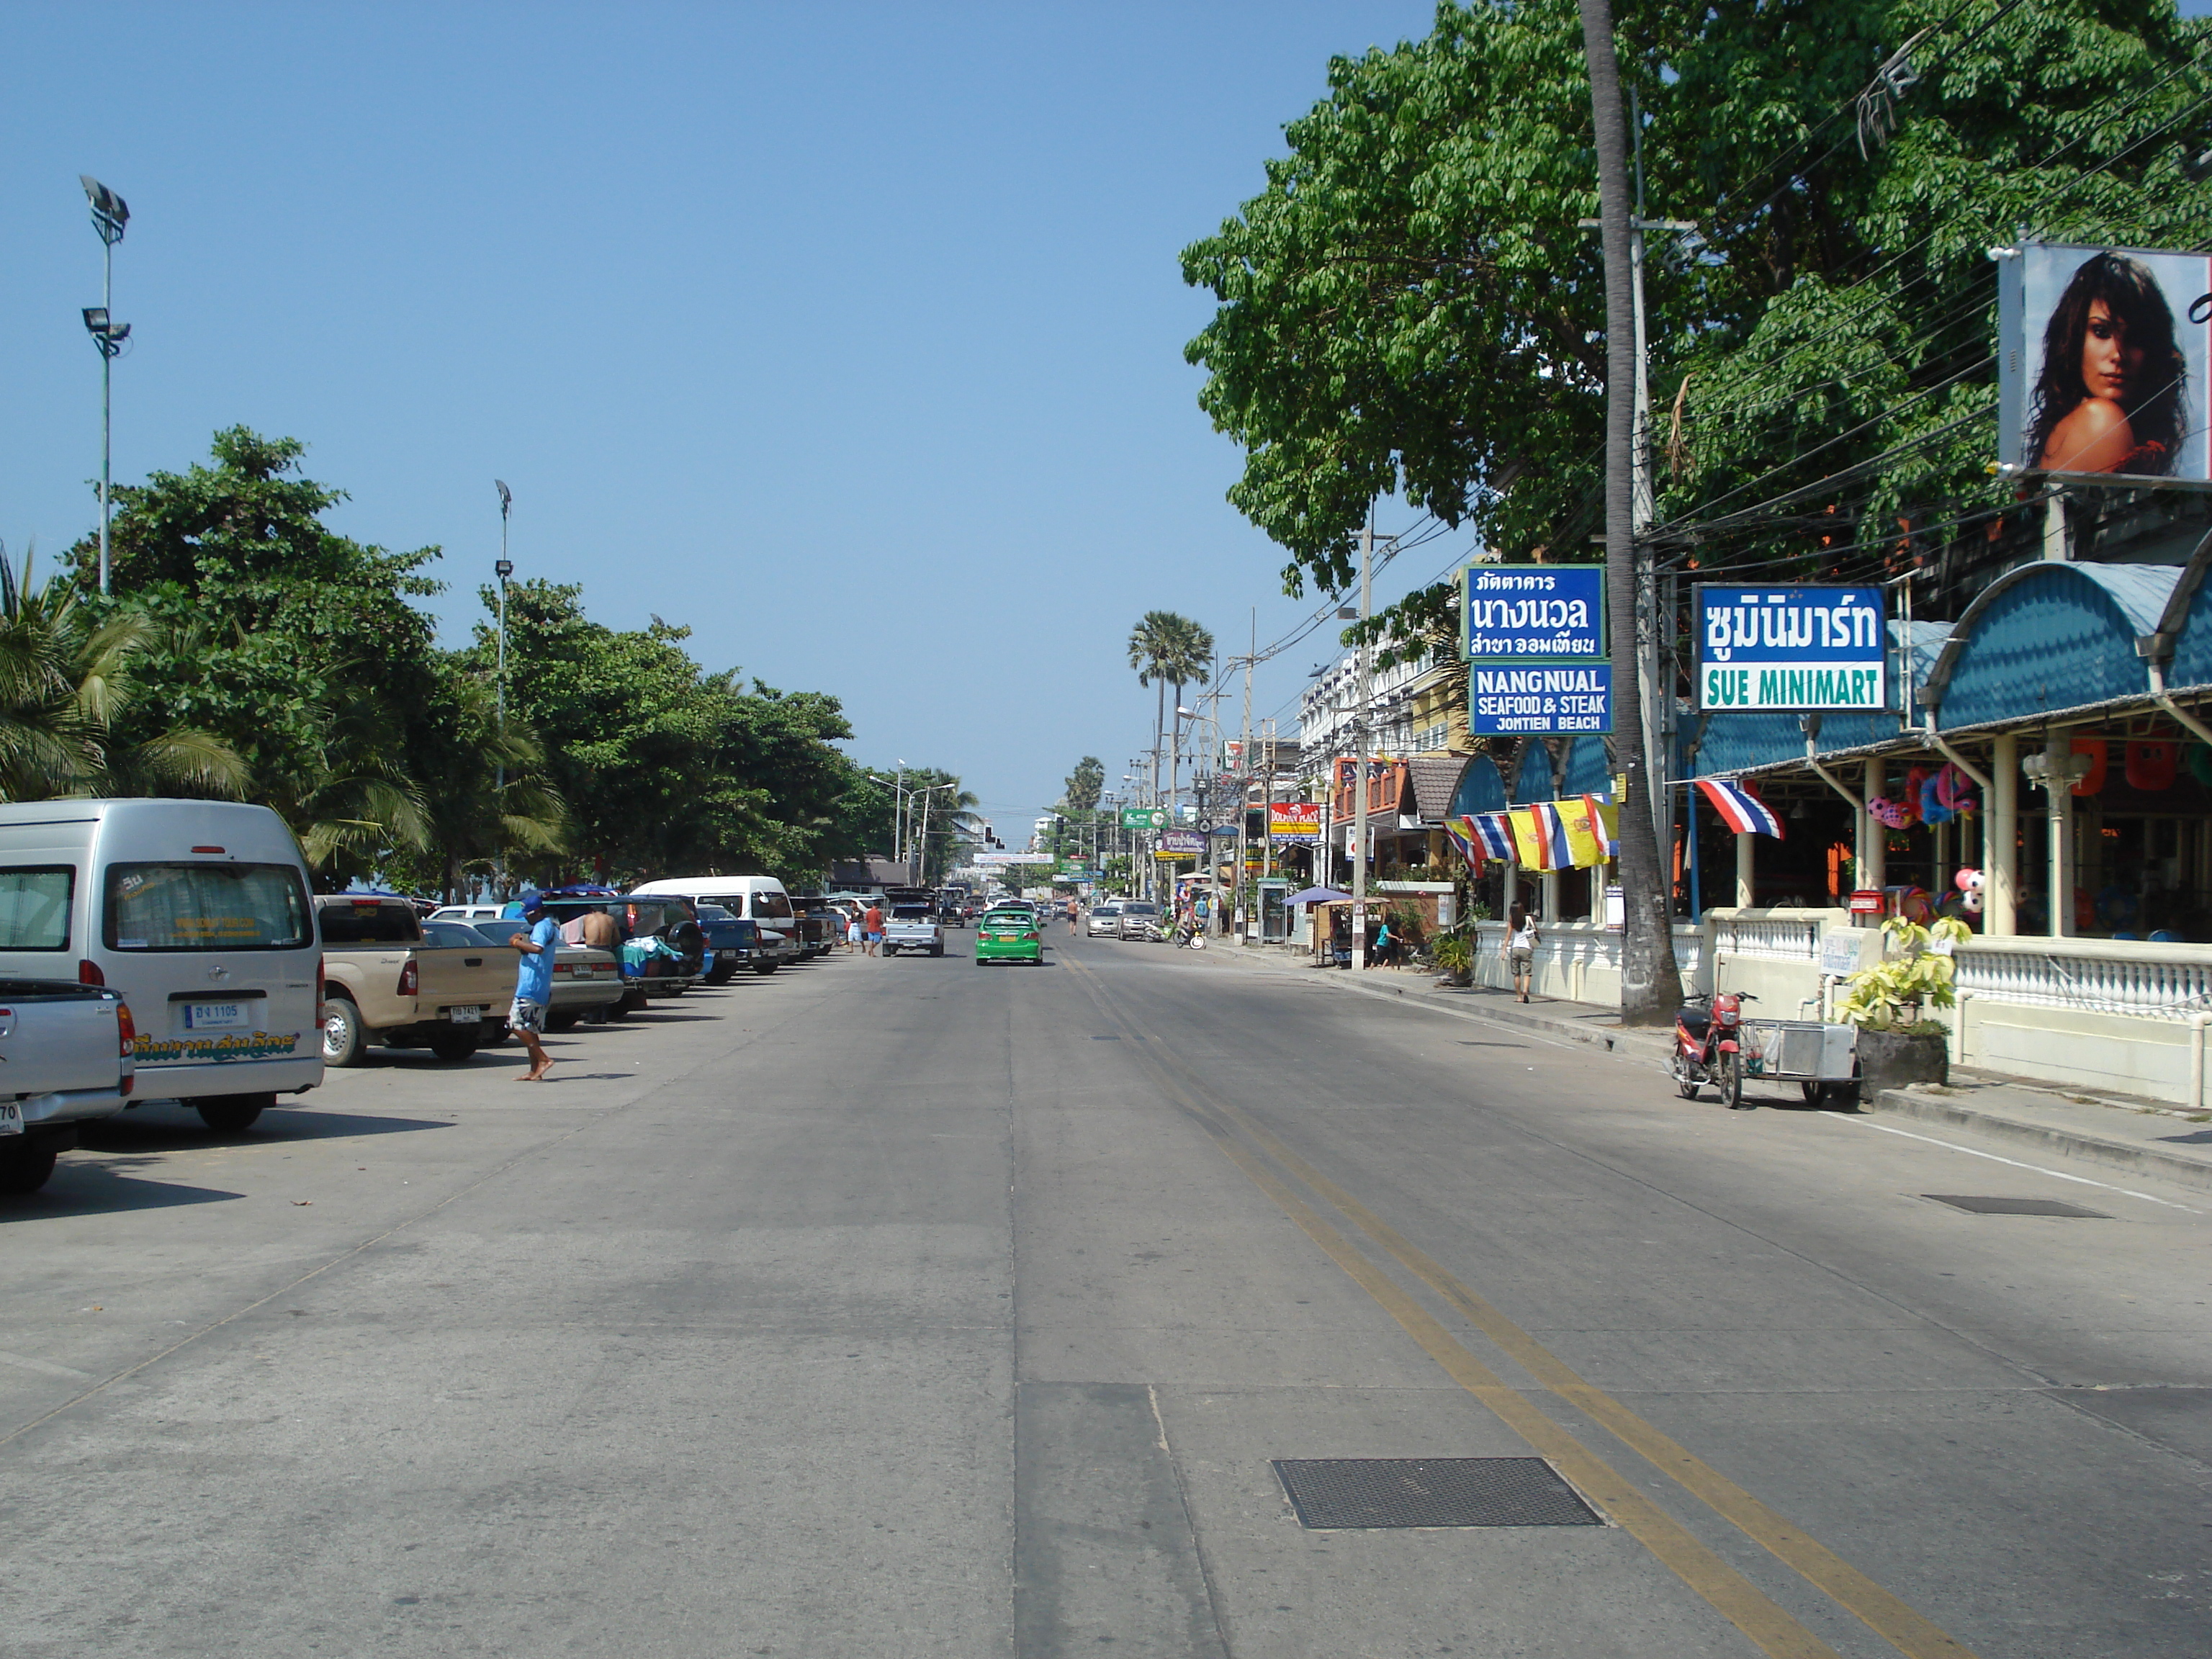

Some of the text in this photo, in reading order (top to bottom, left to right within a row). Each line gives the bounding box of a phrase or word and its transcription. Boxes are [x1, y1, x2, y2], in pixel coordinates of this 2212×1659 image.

[1476, 571, 1555, 590] ภัตตาคาร
[1471, 599, 1588, 629] นางนวล
[1707, 595, 1877, 661] ซูมินิมาร์ท
[1471, 632, 1511, 654] สาขา
[1477, 670, 1606, 693] NANGNUAL
[1707, 669, 1877, 706] SUE MINIMART
[1478, 695, 1606, 715] SEAFOOD & STEAK
[1496, 716, 1600, 731] JOMTIEN BEACH
[1300, 810, 1318, 822] PLACE
[216, 1005, 237, 1017] 1105
